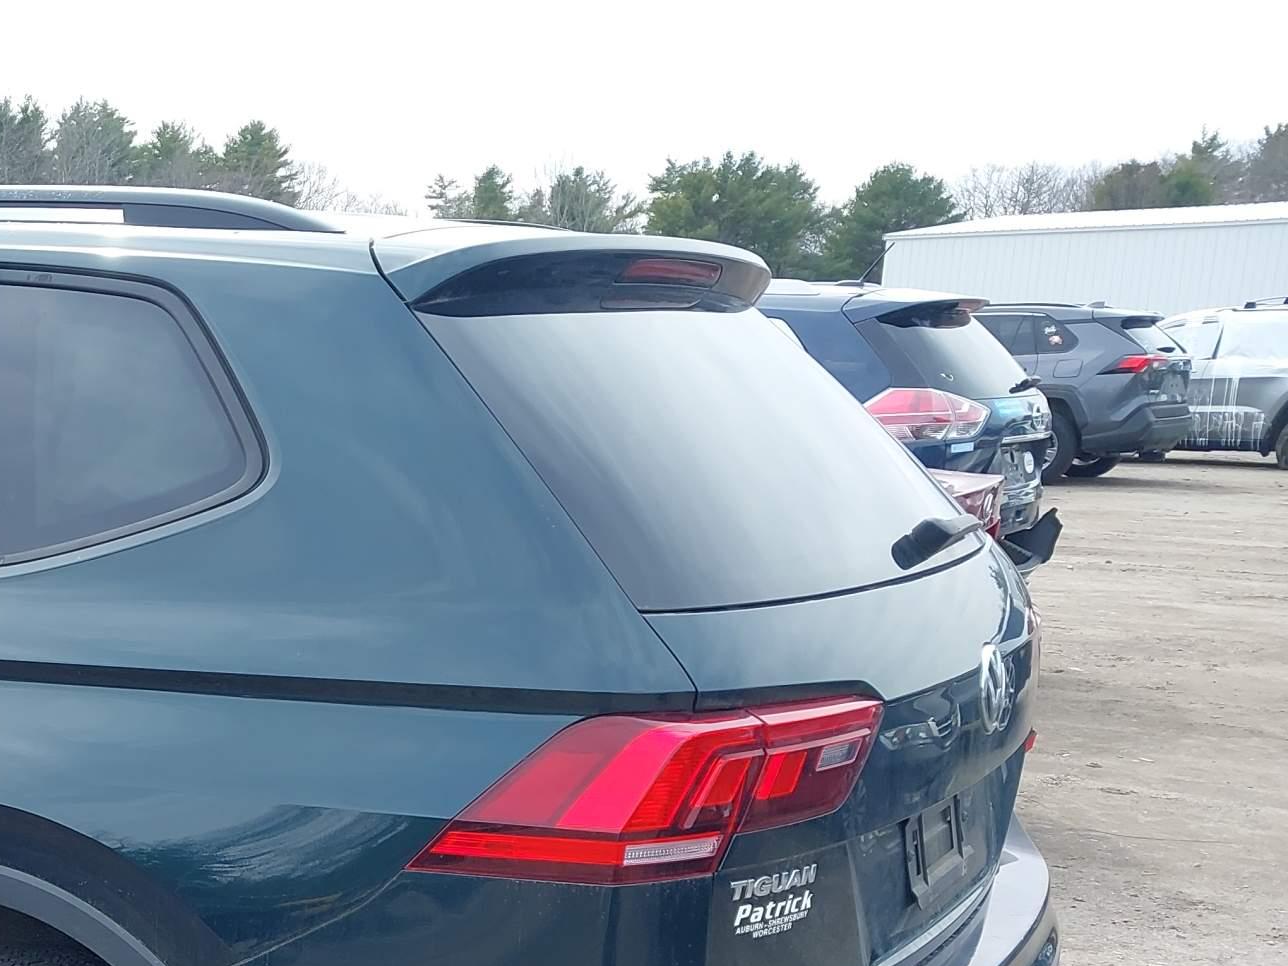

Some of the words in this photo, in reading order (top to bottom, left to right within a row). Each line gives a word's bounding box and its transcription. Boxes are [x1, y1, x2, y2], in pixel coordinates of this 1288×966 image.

[730, 864, 818, 901] TIGUAN
[734, 890, 814, 927] Patrick
[753, 923, 793, 939] WORCESTER
